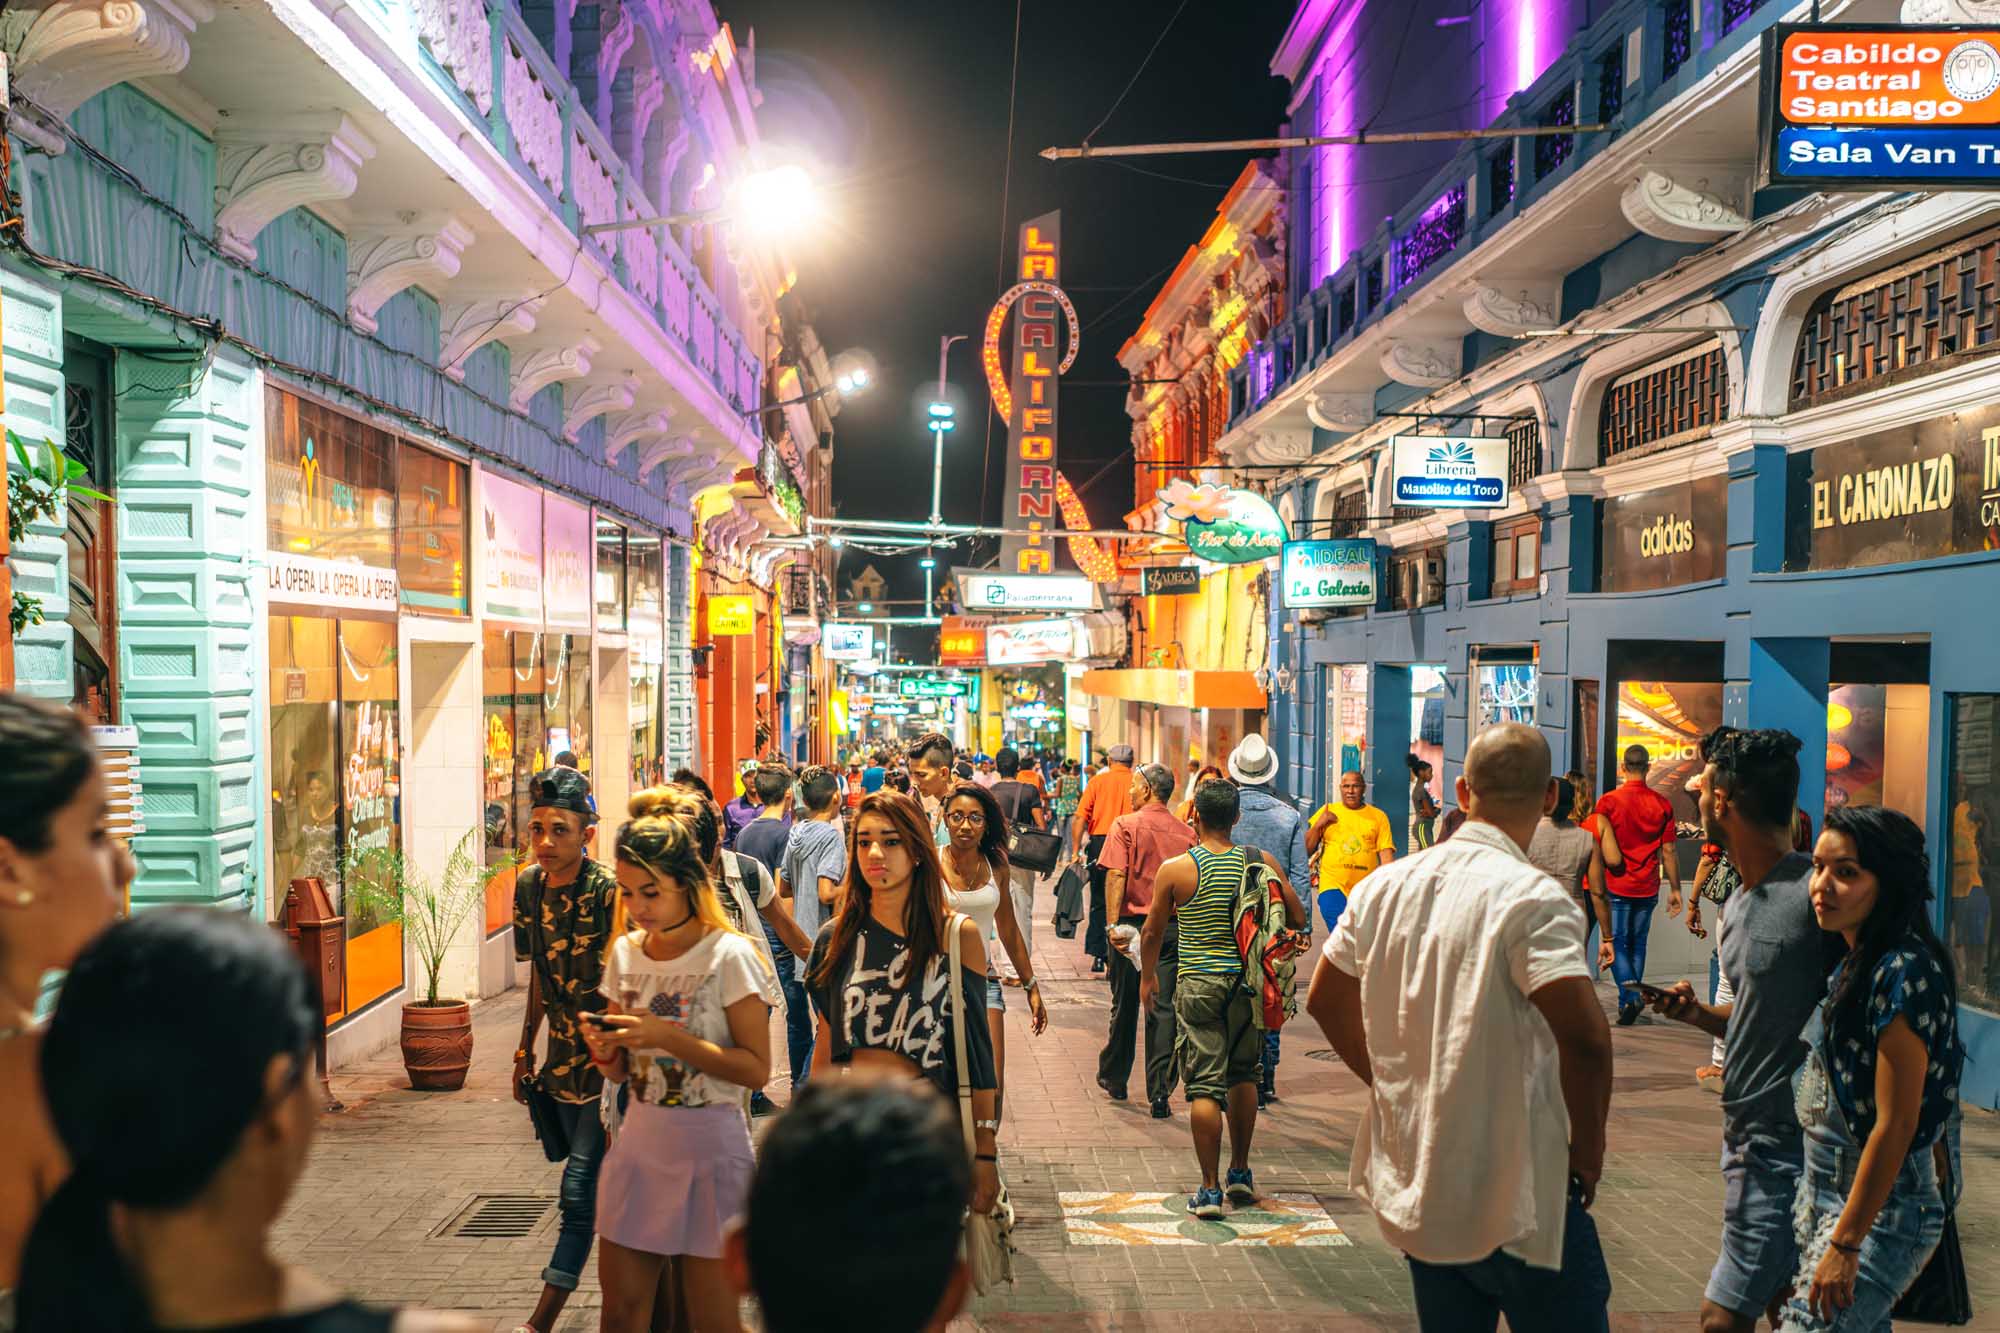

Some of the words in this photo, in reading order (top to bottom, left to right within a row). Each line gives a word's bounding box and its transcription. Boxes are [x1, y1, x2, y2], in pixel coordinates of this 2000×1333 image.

[1792, 43, 1941, 64] Cabildo
[1791, 70, 1920, 91] Teatral
[1790, 96, 1963, 120] Santiago
[1790, 140, 1872, 163] Sala
[1884, 143, 1956, 164] Van
[1022, 227, 1056, 280] LA
[1017, 294, 1056, 574] CALIFORNIA
[1402, 483, 1452, 496] Manolito
[1453, 483, 1471, 496] del
[1472, 484, 1499, 496] Toro
[1813, 480, 1835, 530] EL
[1839, 453, 1956, 526] CAÑONAZO
[1640, 513, 1695, 558] adidas
[1314, 547, 1369, 565] IDEAL
[268, 565, 281, 590] LA
[285, 560, 316, 593] ÓPERA
[318, 572, 331, 596] LA
[362, 577, 372, 599] LA
[1291, 581, 1311, 597] La
[1317, 579, 1371, 597] Galaxia
[843, 986, 946, 1069] PEACE
